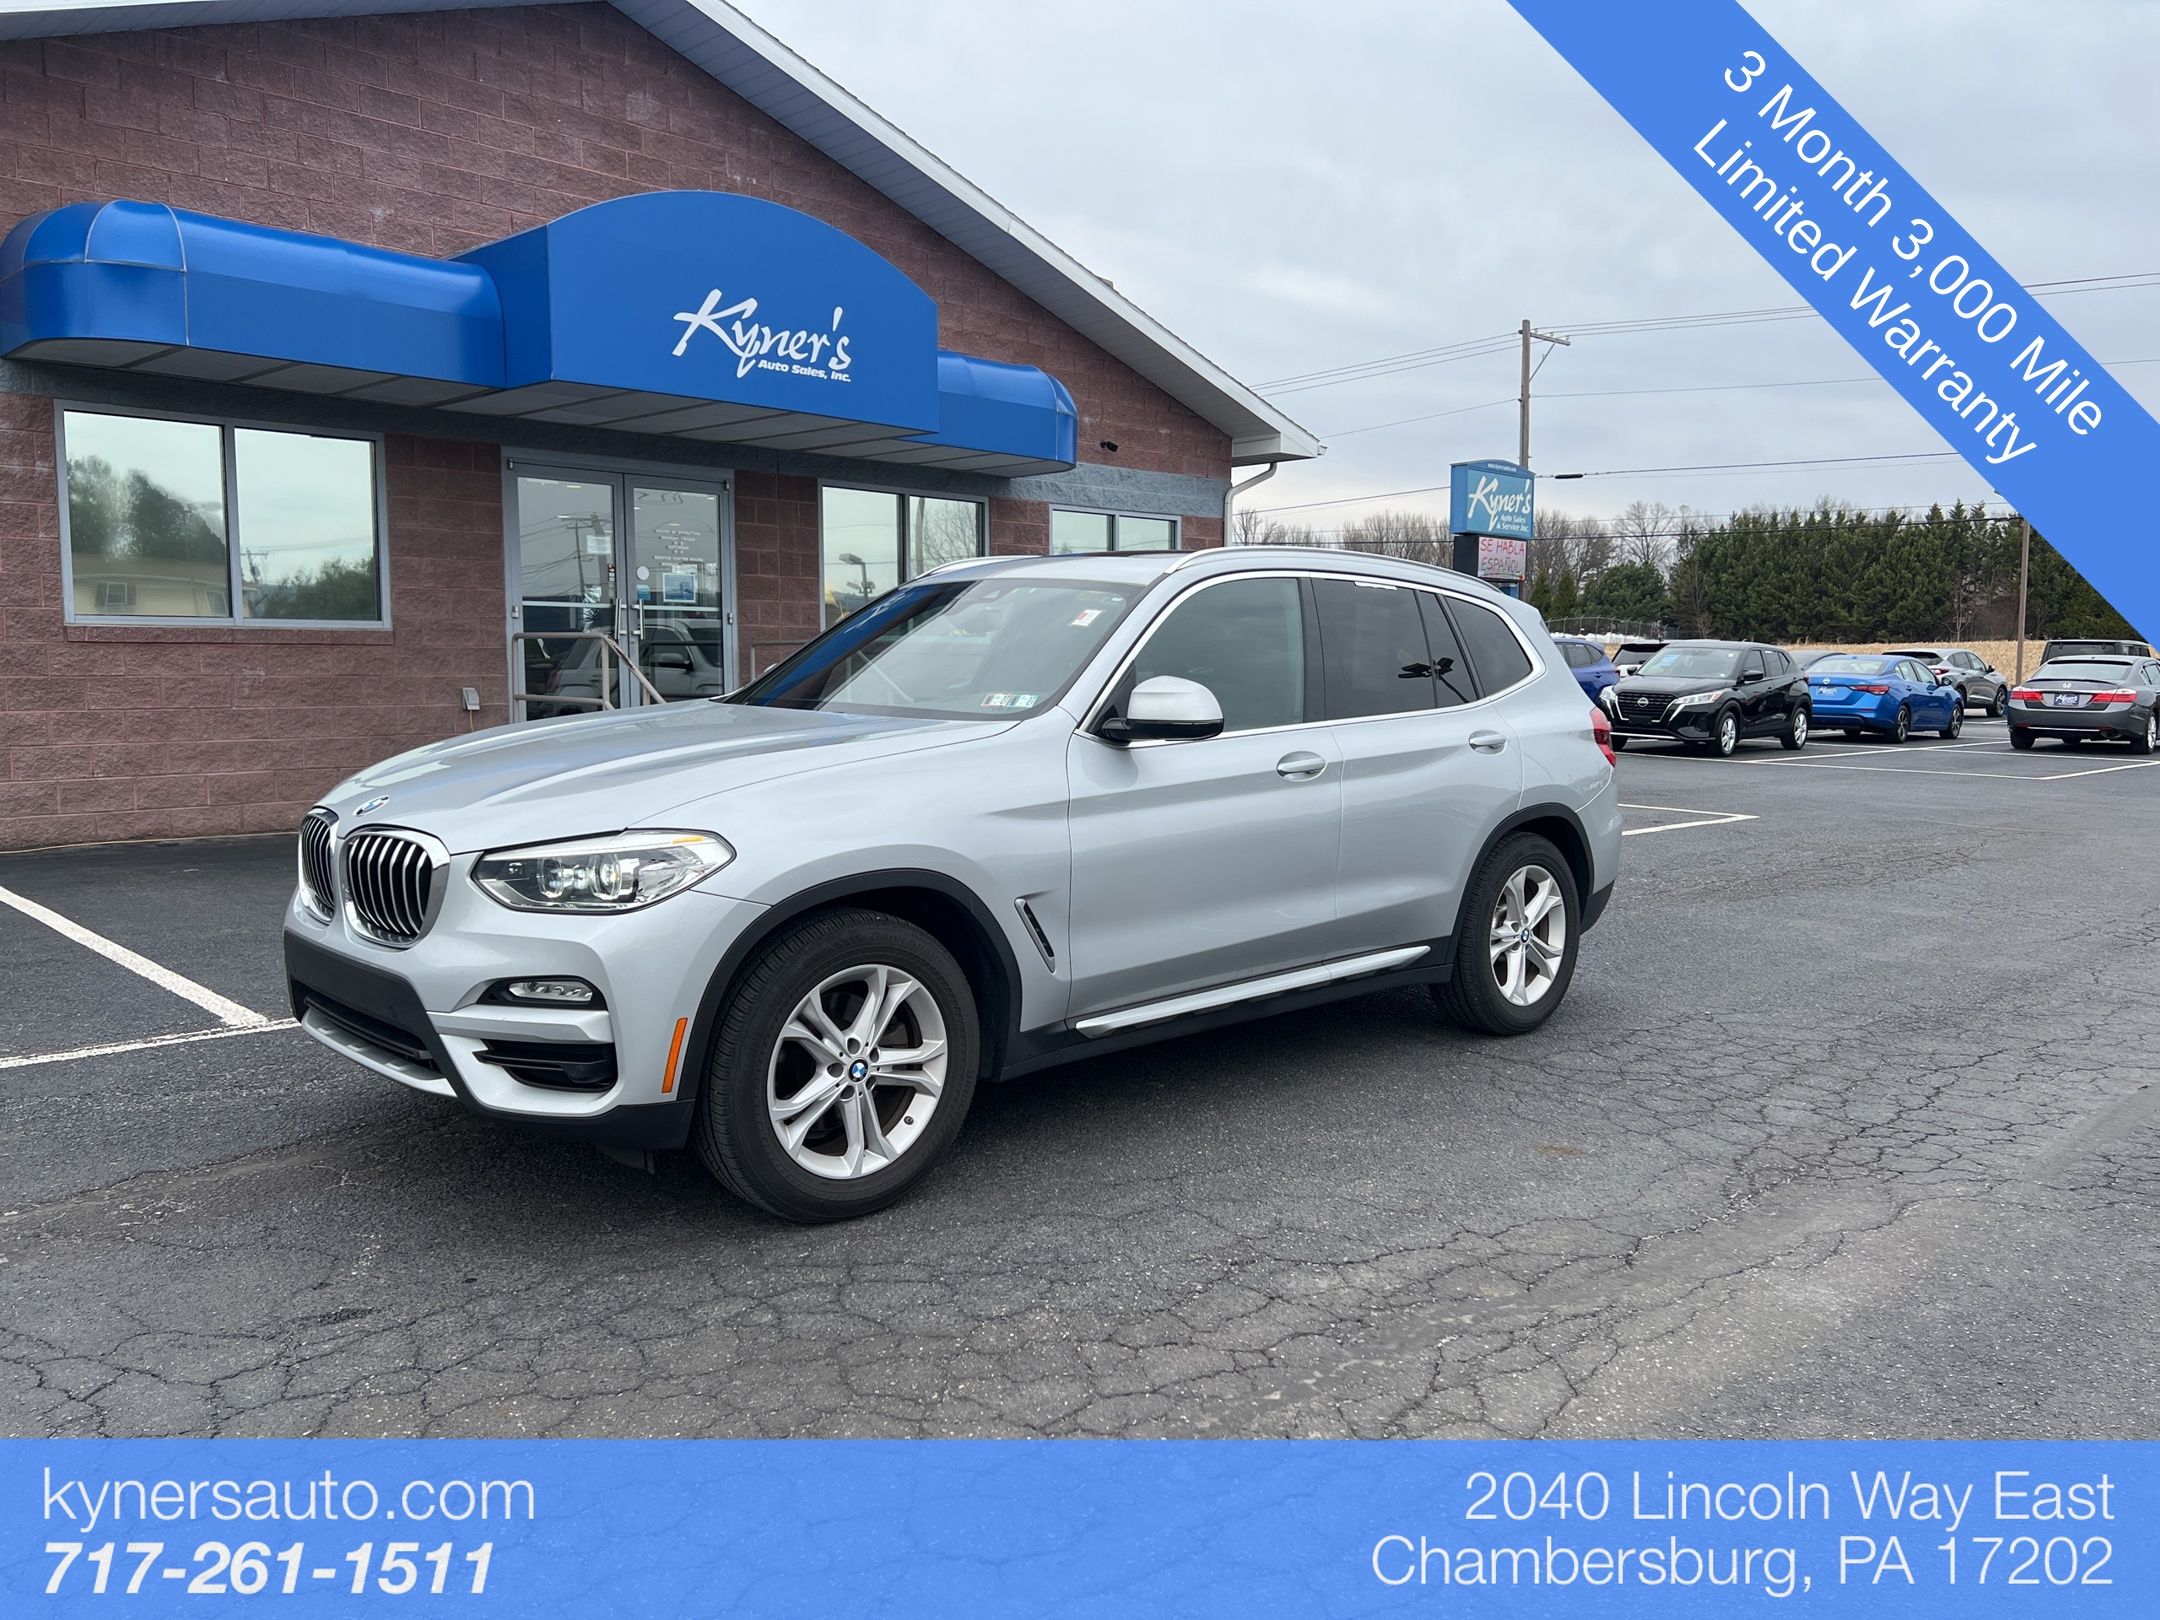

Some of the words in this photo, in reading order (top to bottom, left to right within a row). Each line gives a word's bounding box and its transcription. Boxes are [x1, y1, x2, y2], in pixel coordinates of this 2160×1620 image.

[672, 288, 852, 379] Kyner's
[757, 358, 790, 373] Auto
[791, 363, 828, 380] Sales,
[830, 369, 852, 383] Inc.
[1467, 475, 1532, 532] Kyner's
[1480, 538, 1493, 552] SE
[1496, 540, 1525, 556] HABLA
